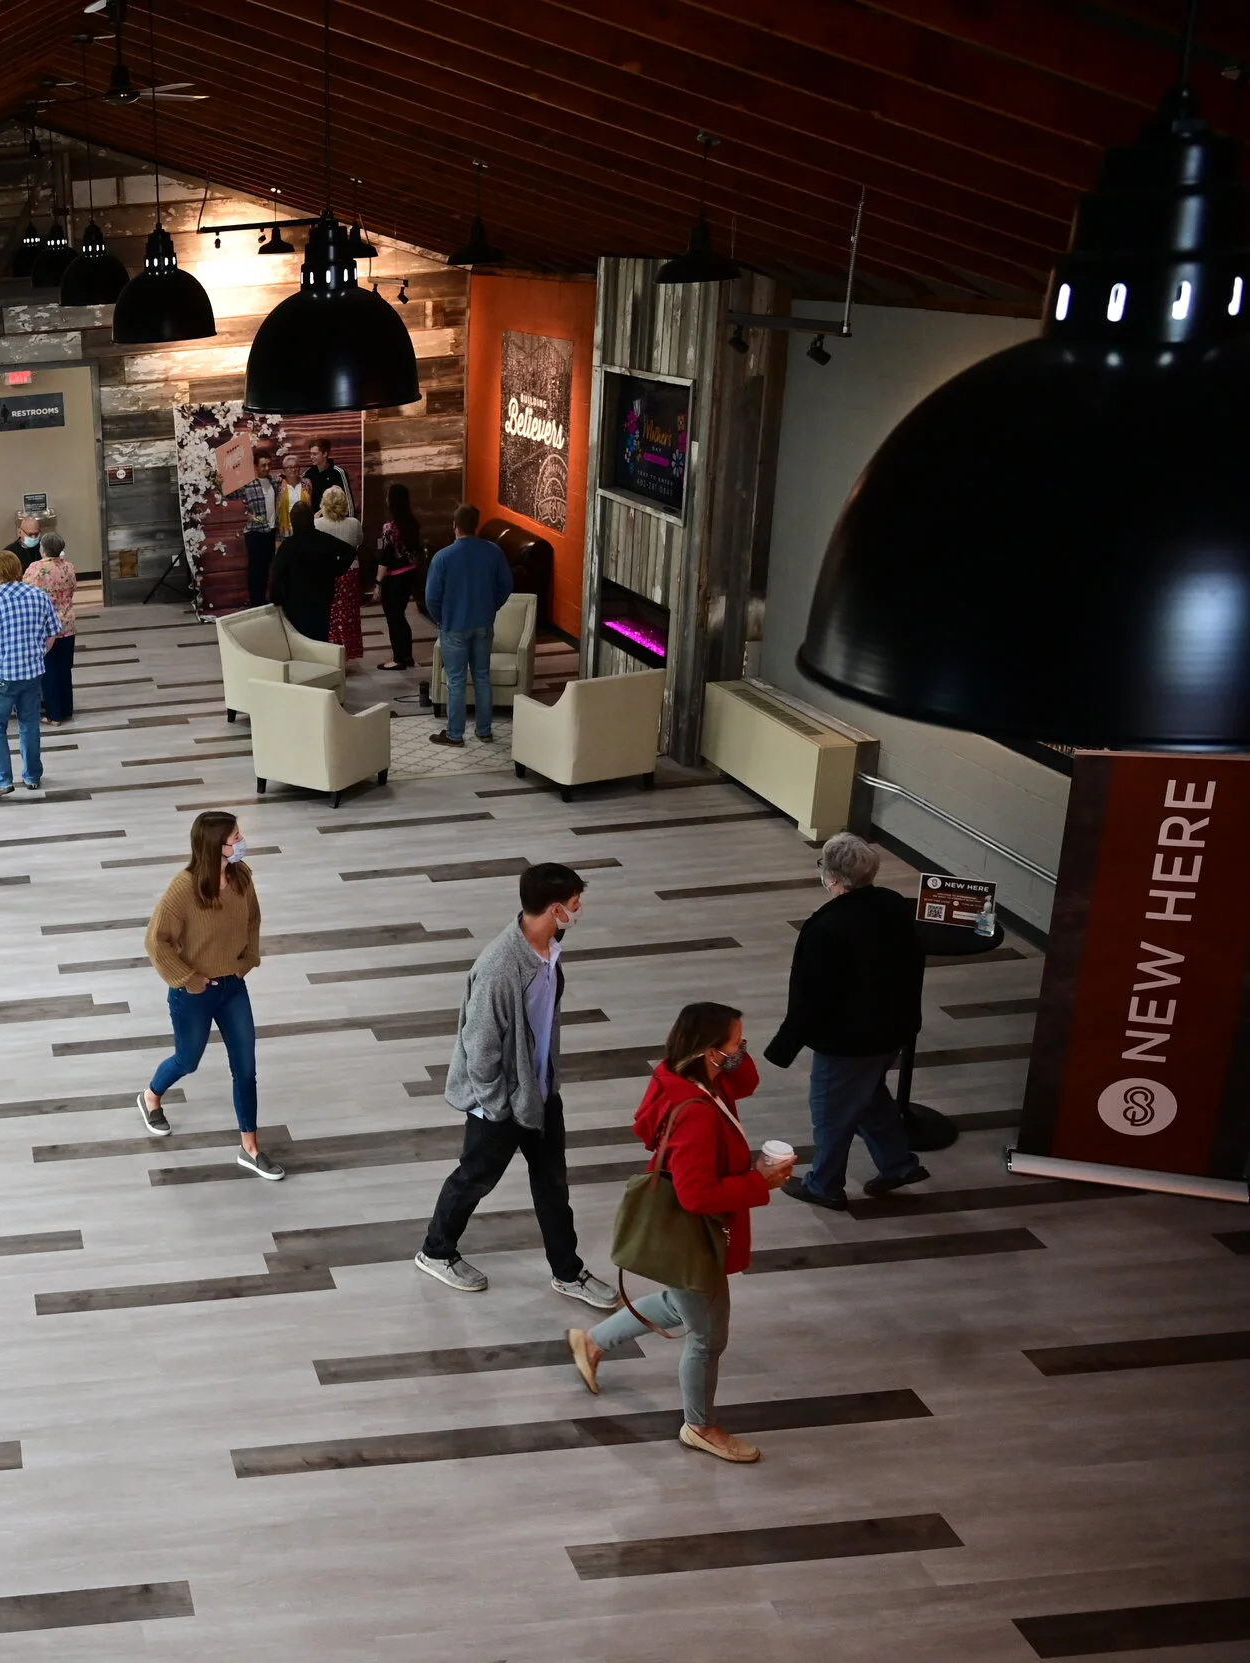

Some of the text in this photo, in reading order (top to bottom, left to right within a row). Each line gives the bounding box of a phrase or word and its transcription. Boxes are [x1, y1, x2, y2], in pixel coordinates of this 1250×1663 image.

[520, 392, 547, 409] BUILDING
[11, 406, 59, 418] RESTROOMS
[505, 397, 565, 450] Believers
[944, 881, 989, 892] NEW HERE
[1121, 779, 1217, 1063] NEW HERE
